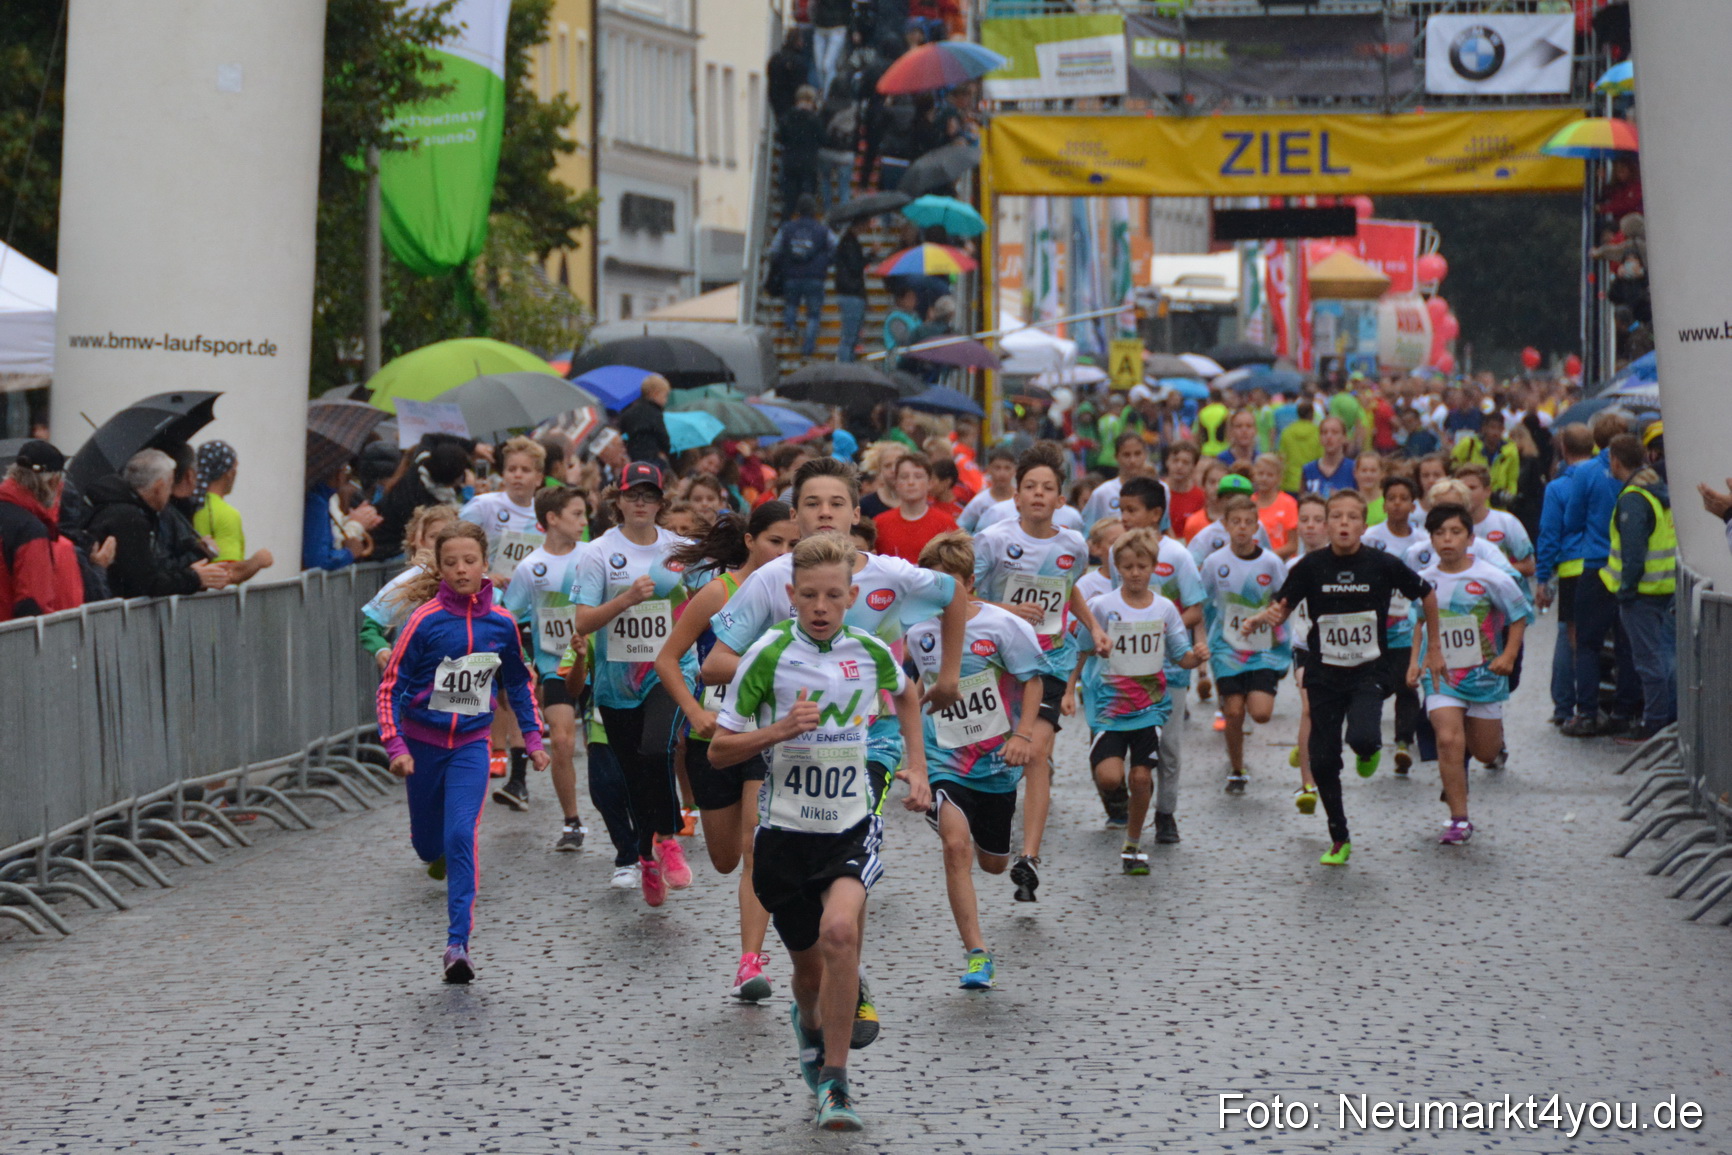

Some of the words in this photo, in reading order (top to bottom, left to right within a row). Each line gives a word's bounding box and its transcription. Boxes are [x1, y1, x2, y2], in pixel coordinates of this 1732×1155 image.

[1133, 38, 1227, 59] BOCK
[1220, 131, 1351, 175] ZIEL
[68, 332, 278, 357] www.bmw-laufsport.de
[1118, 355, 1135, 375] A
[502, 541, 534, 561] 402
[1321, 584, 1370, 592] STANNO
[1010, 587, 1062, 612] 4052
[545, 618, 575, 638] 401
[614, 616, 666, 638] 4008
[1326, 624, 1372, 646] 4043
[1115, 633, 1161, 654] 4107
[1441, 628, 1475, 648] 109
[626, 644, 654, 653] Selina
[442, 668, 493, 693] 4019
[449, 696, 481, 706] Samin
[941, 686, 997, 722] 4046
[816, 732, 861, 743] ENERGIE
[963, 723, 983, 736] Tim
[817, 747, 858, 759] BOCK
[783, 765, 857, 799] 4002
[800, 805, 838, 821] Niklas
